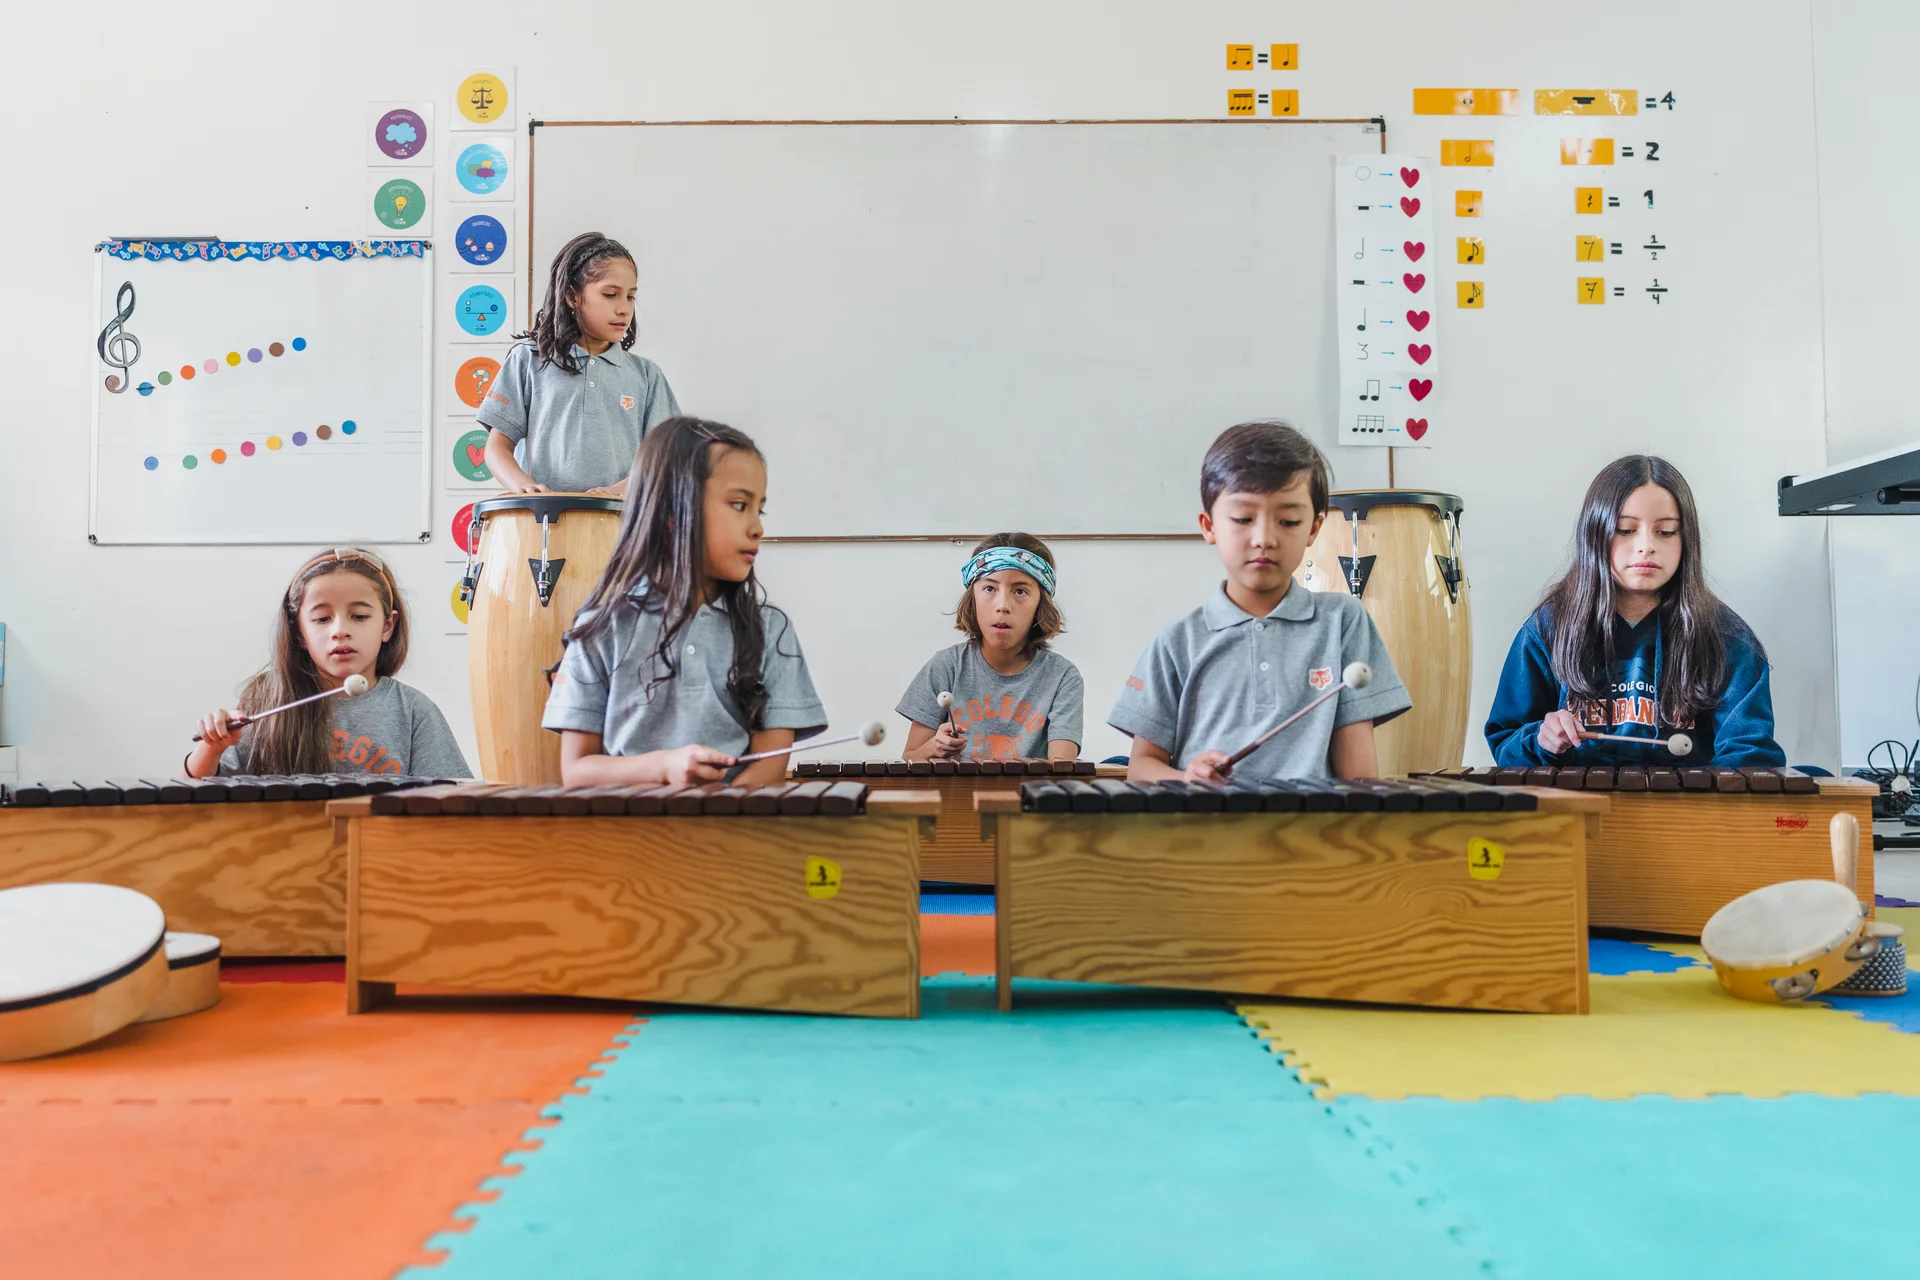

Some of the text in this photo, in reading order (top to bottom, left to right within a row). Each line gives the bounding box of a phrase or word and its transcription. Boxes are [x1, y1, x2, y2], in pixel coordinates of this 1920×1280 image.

[1660, 91, 1676, 110] 4
[1645, 142, 1660, 161] 2
[1643, 190, 1654, 209] 1
[1611, 680, 1655, 694] COLEGIO
[329, 729, 402, 775] EGIO
